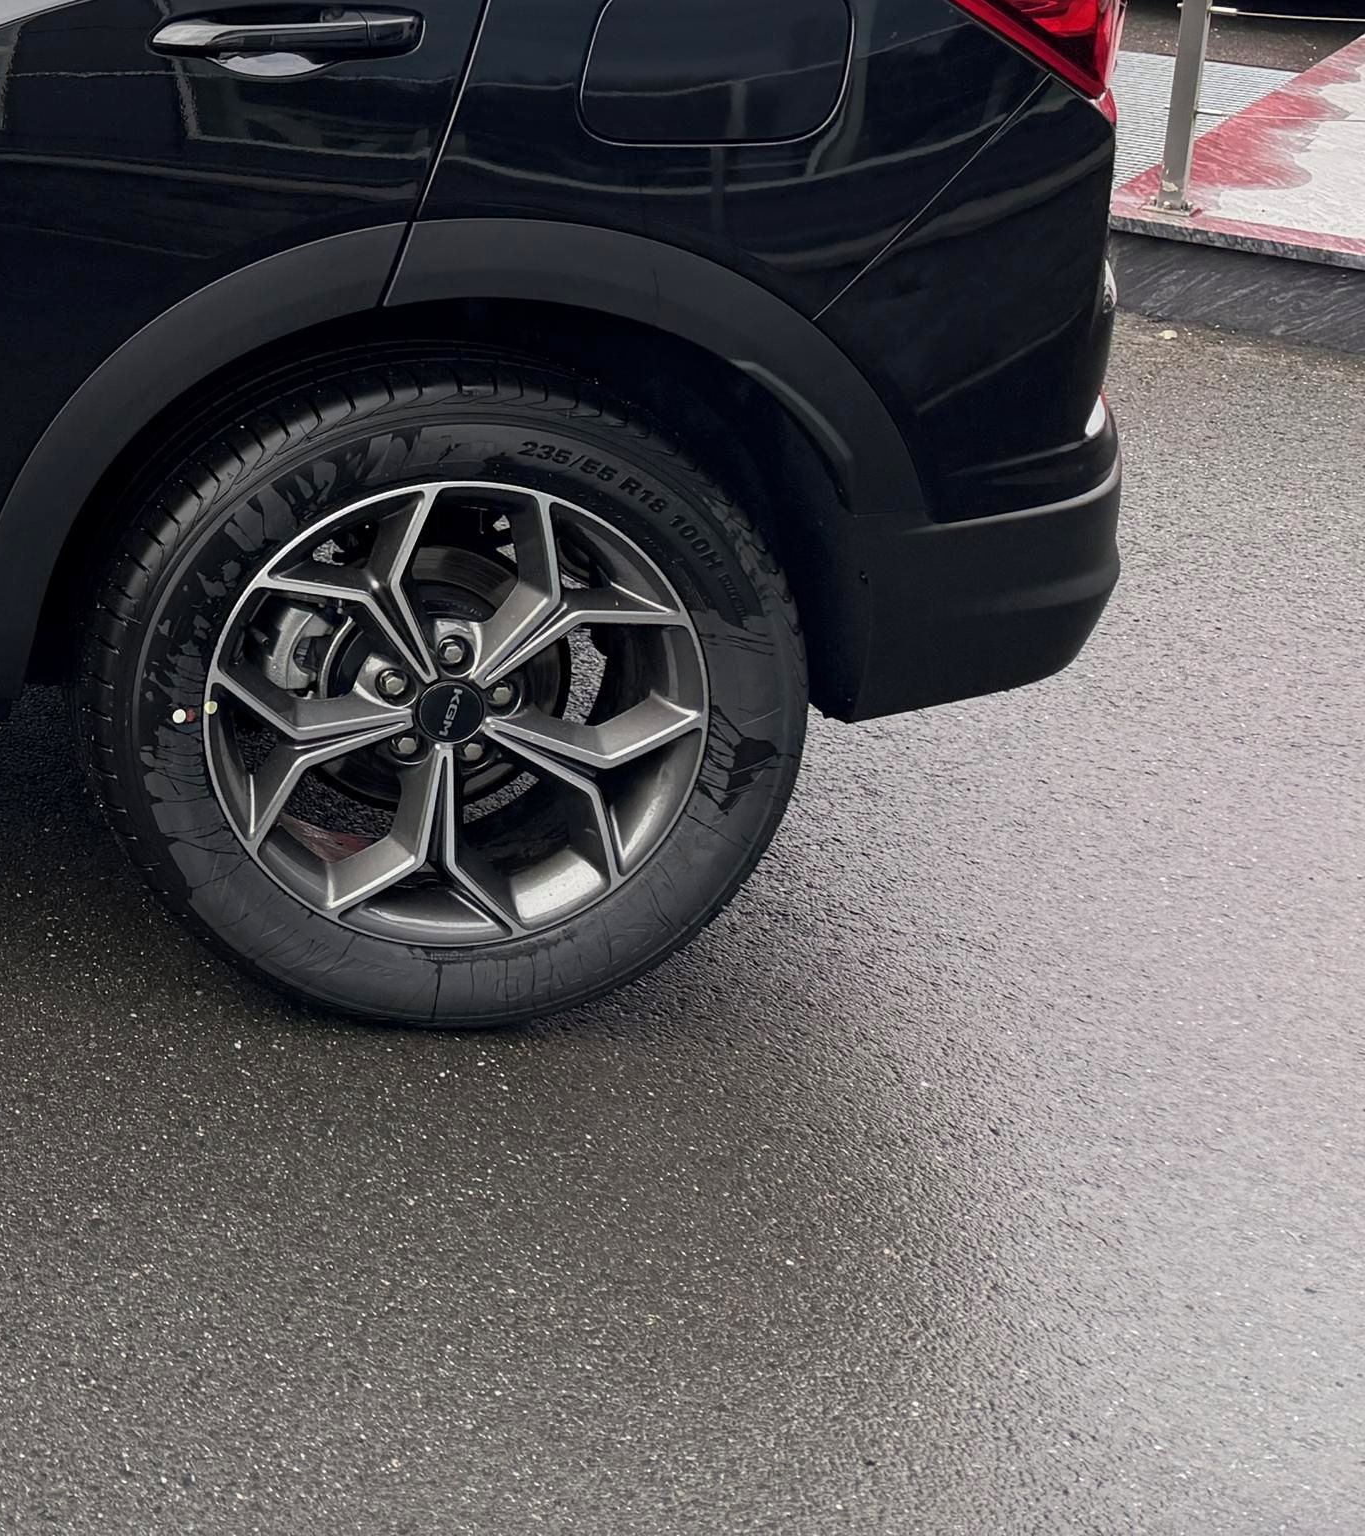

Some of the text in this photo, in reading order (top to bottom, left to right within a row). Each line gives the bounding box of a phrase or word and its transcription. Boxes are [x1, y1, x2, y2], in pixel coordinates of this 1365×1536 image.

[517, 440, 618, 482] 235/55
[619, 475, 669, 514] R18
[438, 687, 463, 737] KGM
